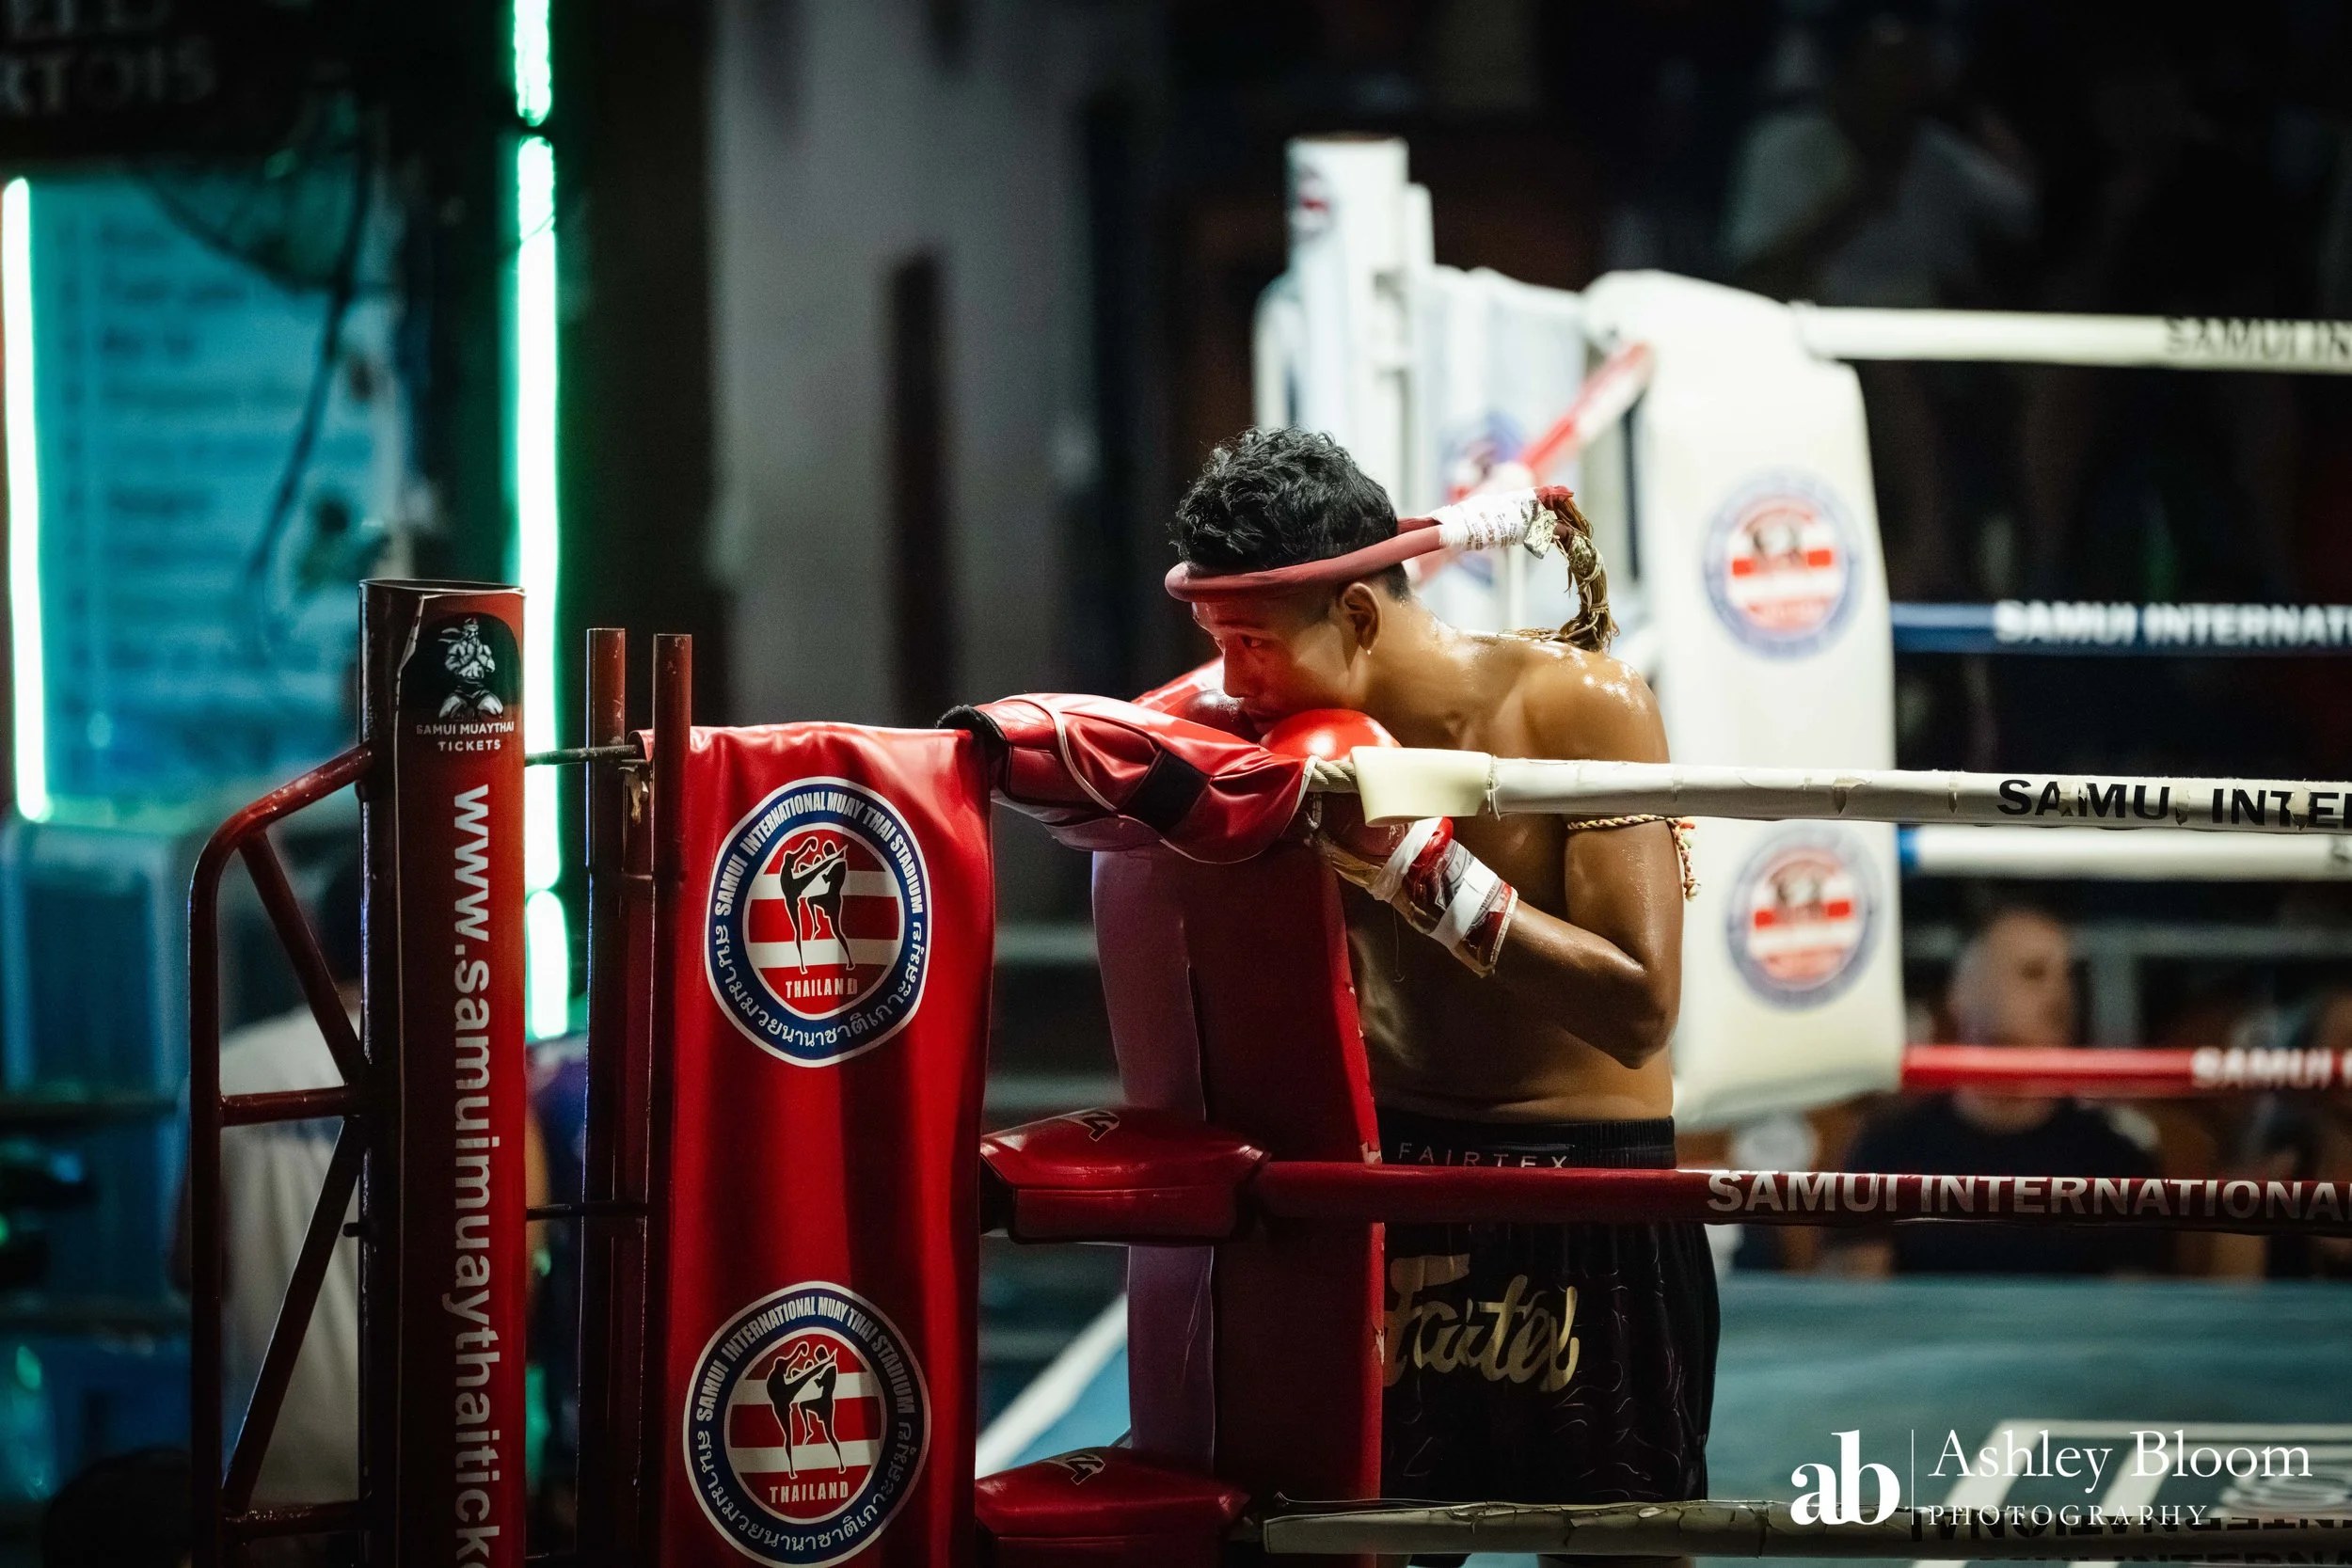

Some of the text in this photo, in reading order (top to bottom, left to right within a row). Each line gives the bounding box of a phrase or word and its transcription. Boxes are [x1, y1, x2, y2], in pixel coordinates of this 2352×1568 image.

[1994, 599, 2138, 646] SAMUI
[417, 721, 515, 736] SAMUI MUAYTHAI
[437, 739, 501, 752] TICKETS
[1997, 779, 2352, 830] SAMU INTE
[714, 791, 924, 917] SAMUI INTERNATIONAL MUAY THAI STADIUM
[786, 978, 858, 999] THAILAND
[442, 784, 501, 1568] www.samuimuaythaitick
[1398, 1142, 1567, 1168] FAIRTEX
[1706, 1170, 2352, 1222] SAMUI INTERNATIONA
[695, 1296, 916, 1422] SAMUI INTERNATIONAL MUAY THAI STADIUM
[770, 1481, 850, 1504] THAILAND
